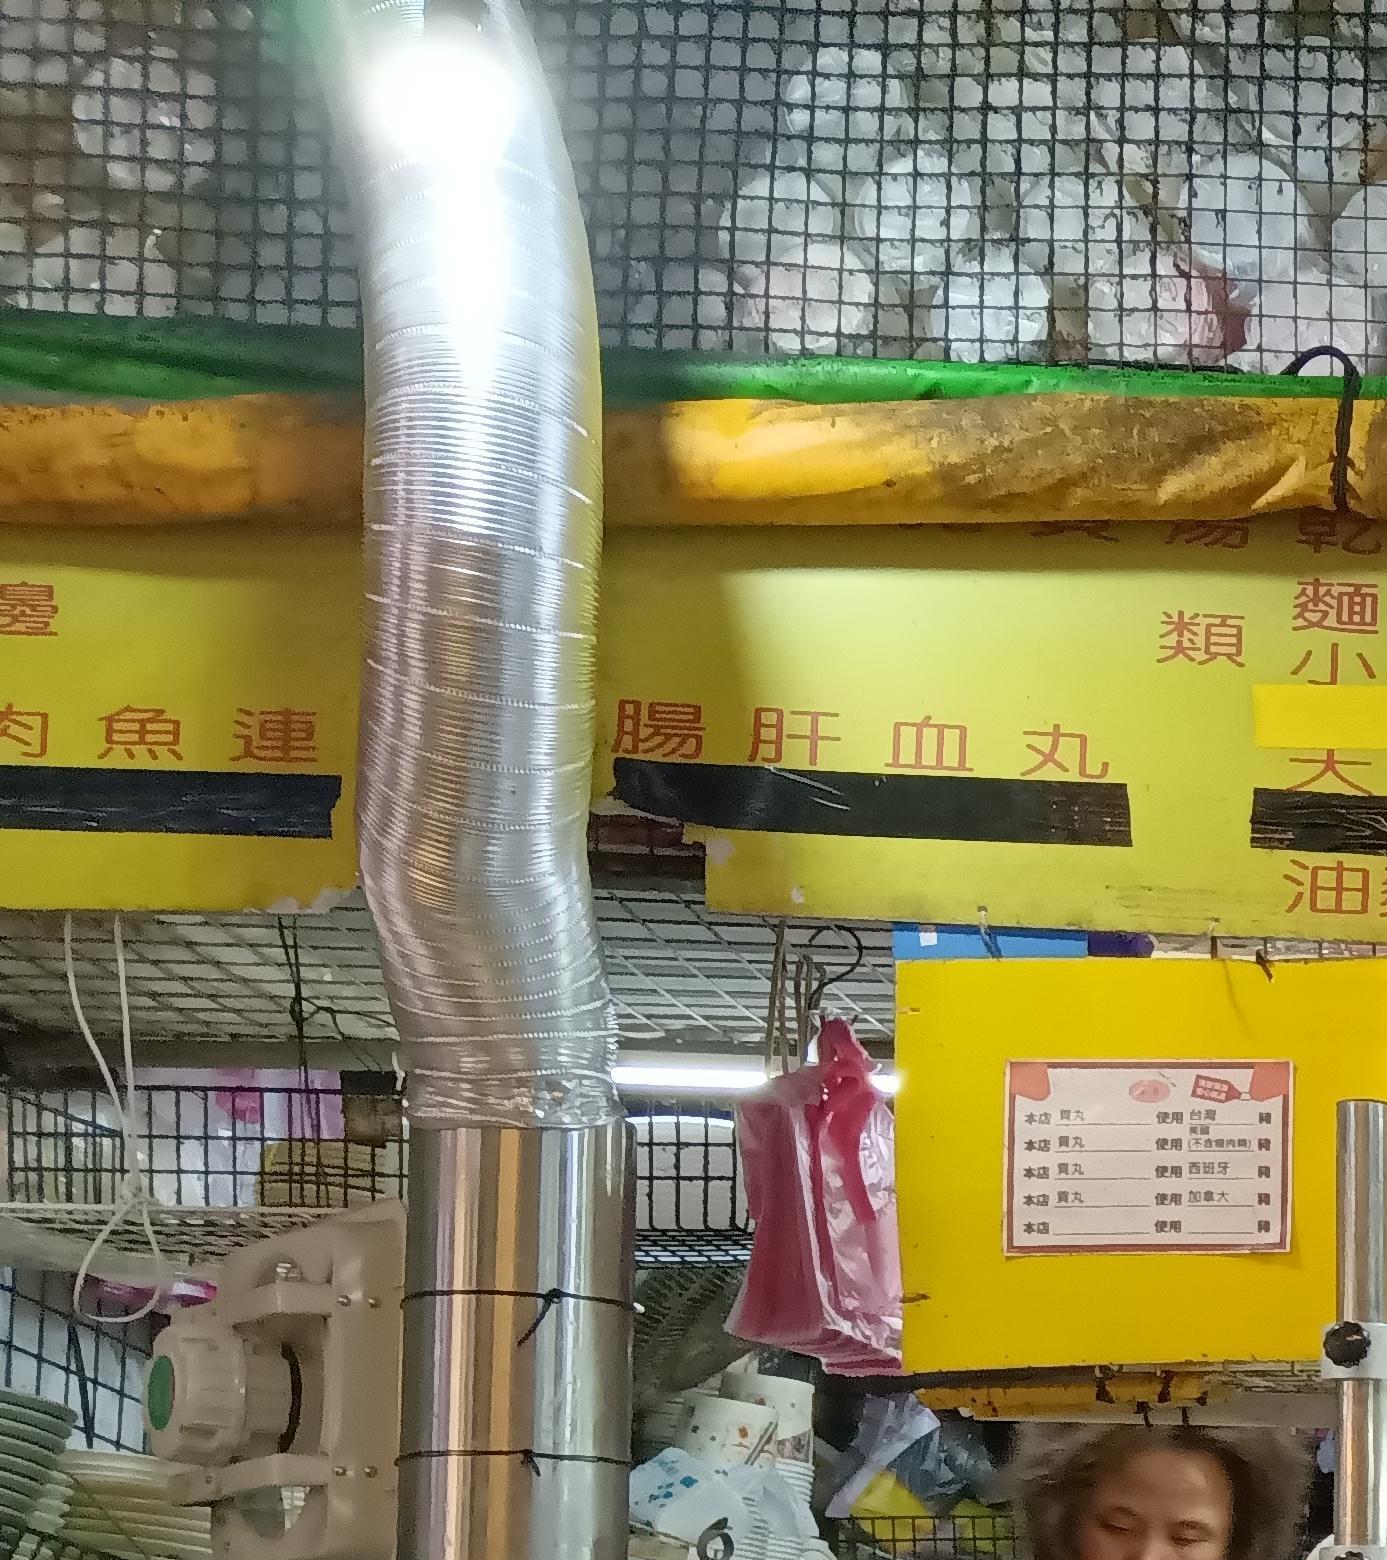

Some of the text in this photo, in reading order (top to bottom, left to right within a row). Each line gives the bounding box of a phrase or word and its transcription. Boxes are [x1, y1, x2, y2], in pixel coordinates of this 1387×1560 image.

[1024, 1112, 1051, 1126] 本店
[1156, 1111, 1184, 1124] 使用
[1024, 1139, 1051, 1152] 本店
[1155, 1138, 1183, 1151] 使用
[1023, 1166, 1050, 1180] 本店
[1155, 1165, 1183, 1179] 使用
[1188, 1161, 1231, 1175] 西班牙
[1023, 1193, 1050, 1207] 本店
[1154, 1193, 1183, 1206] 使用
[1188, 1190, 1230, 1203] 加拿大
[1023, 1221, 1050, 1235] 本店
[1154, 1220, 1182, 1234] 使用
